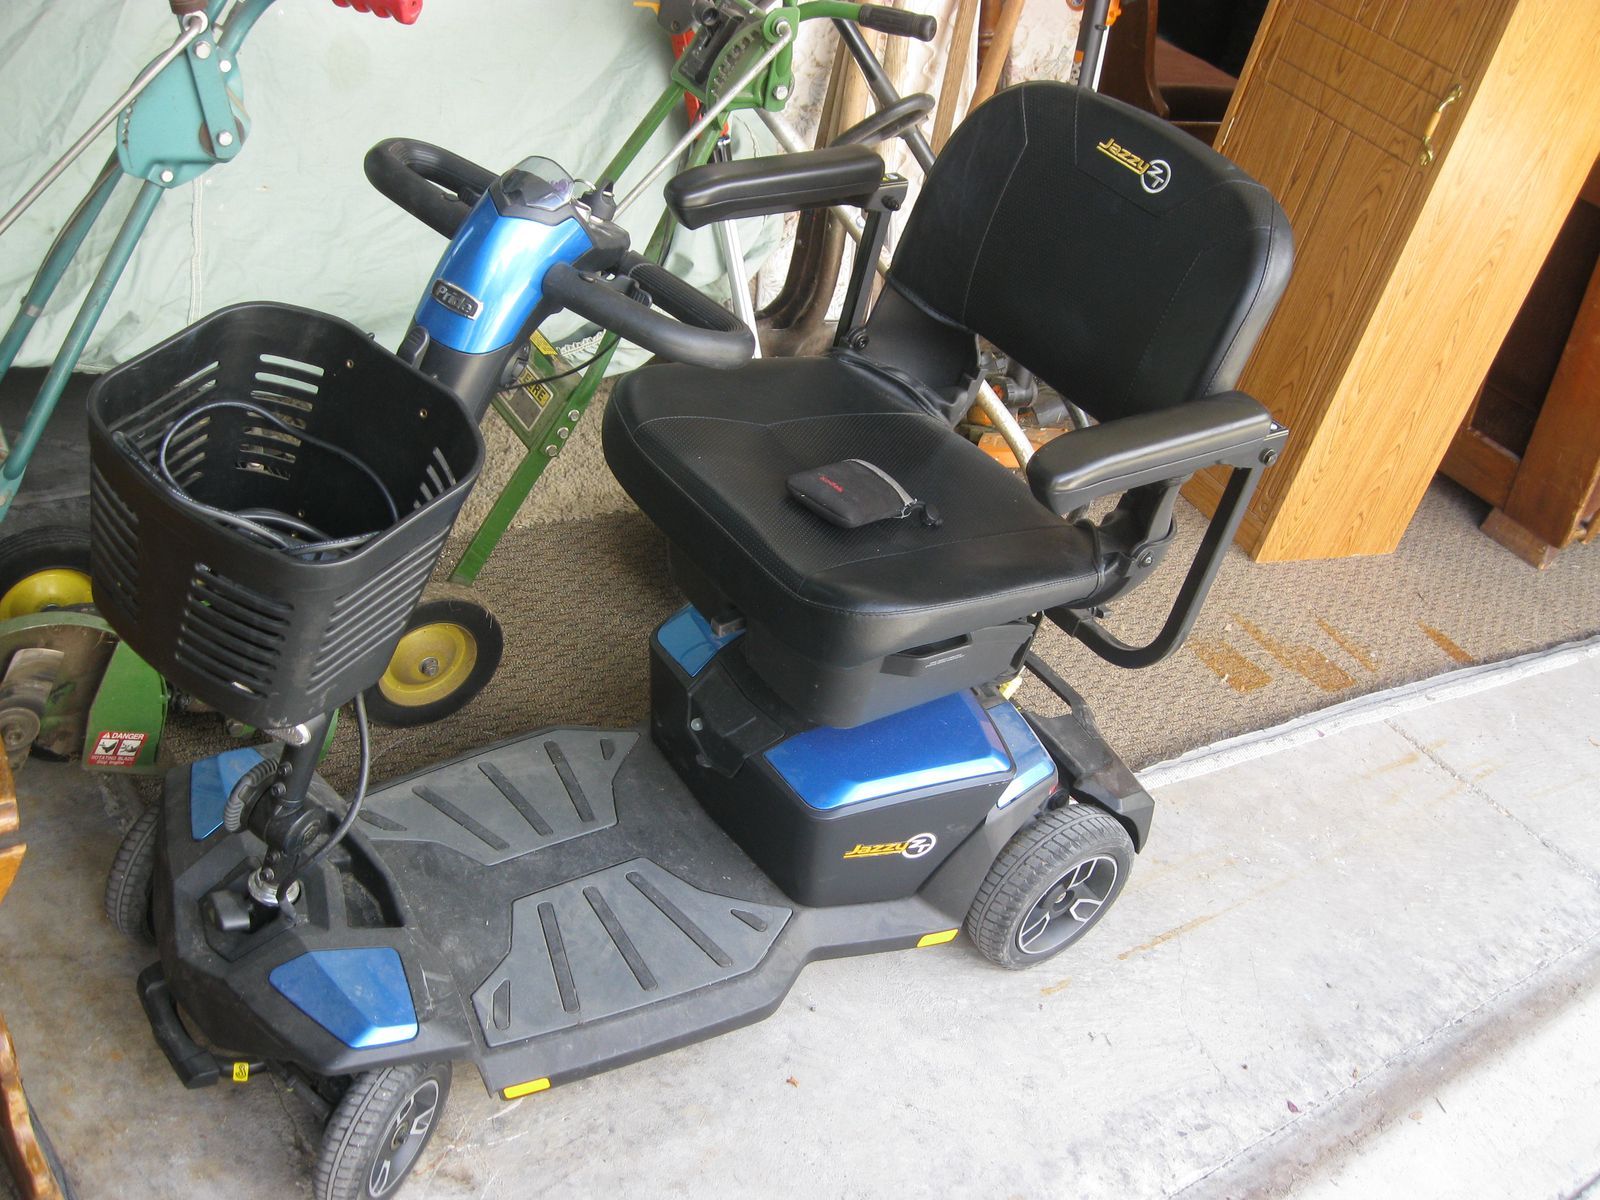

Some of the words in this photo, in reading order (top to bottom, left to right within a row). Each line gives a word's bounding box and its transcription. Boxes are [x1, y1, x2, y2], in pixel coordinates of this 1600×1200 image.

[1096, 138, 1150, 175] Jazzy
[436, 284, 473, 313] Pride
[112, 732, 145, 740] DANGER
[843, 841, 909, 858] Jazzy
